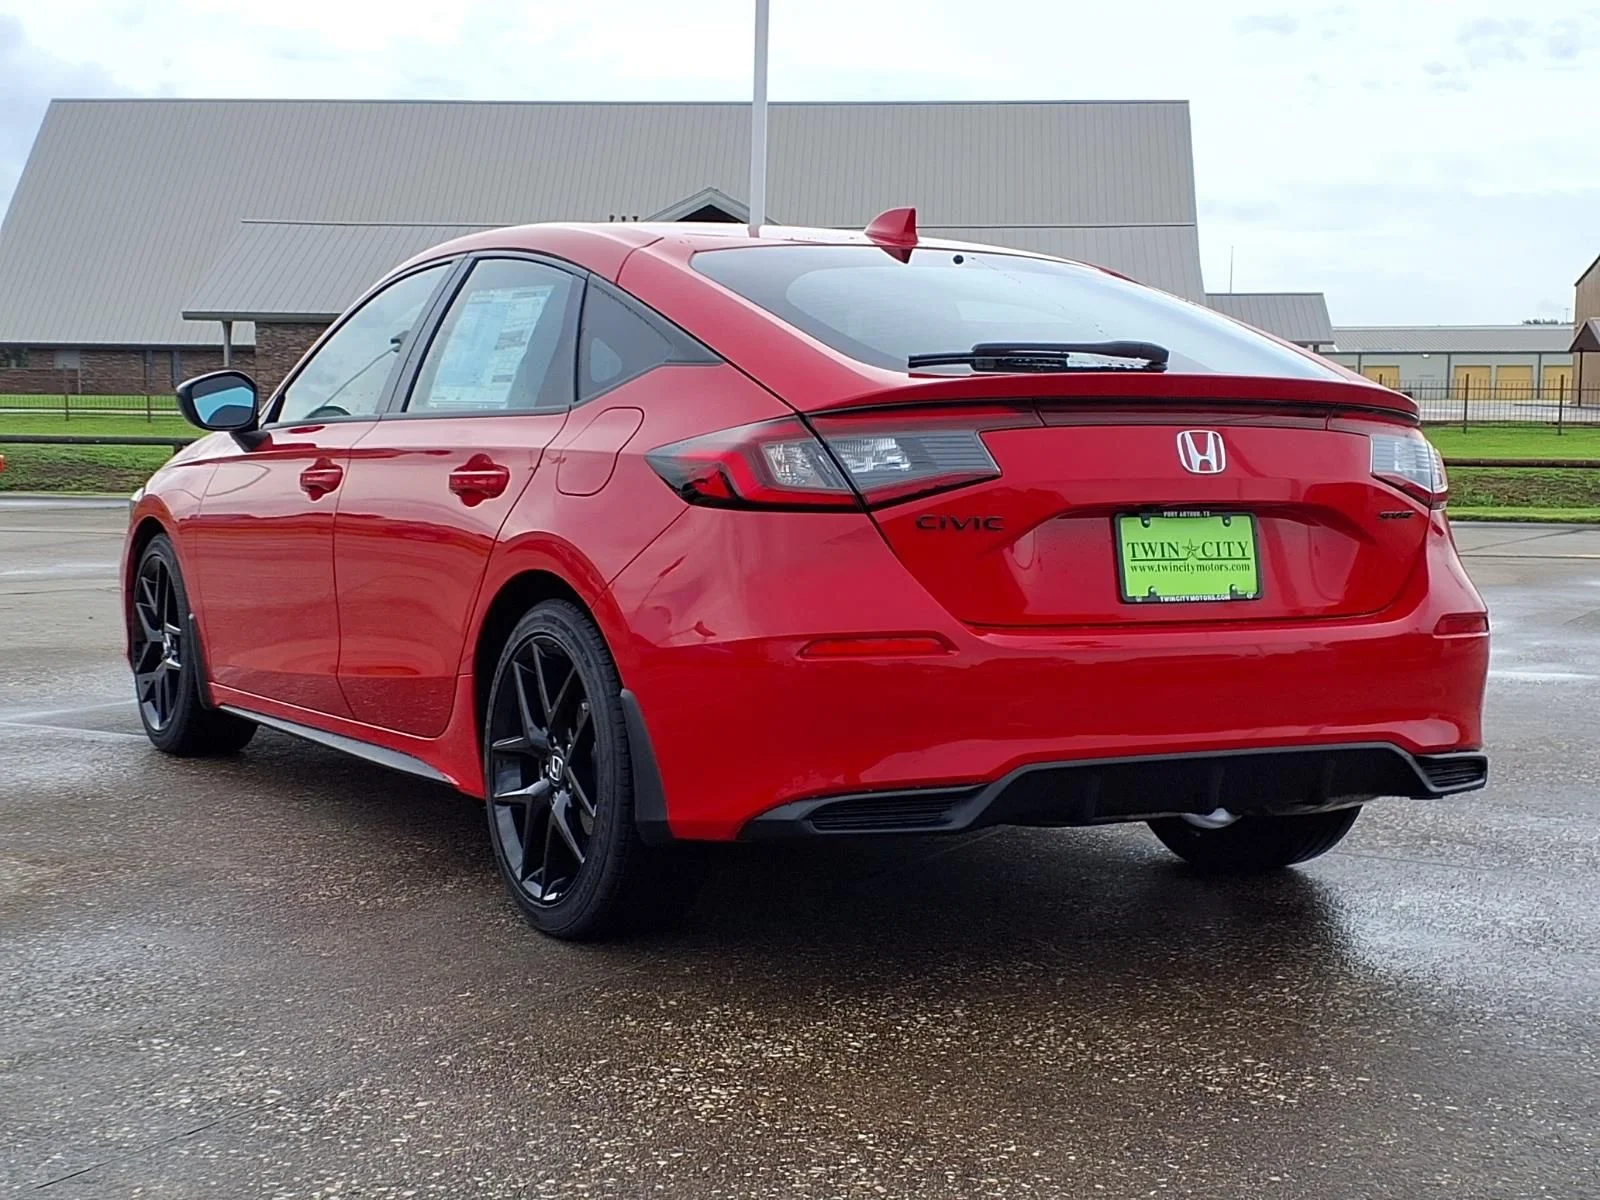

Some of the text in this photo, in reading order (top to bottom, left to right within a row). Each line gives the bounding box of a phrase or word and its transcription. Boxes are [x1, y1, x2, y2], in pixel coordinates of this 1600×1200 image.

[915, 514, 1005, 531] CIVIC
[1127, 541, 1249, 558] TWIN CITY
[1130, 561, 1250, 574] www.twincitymotors.com
